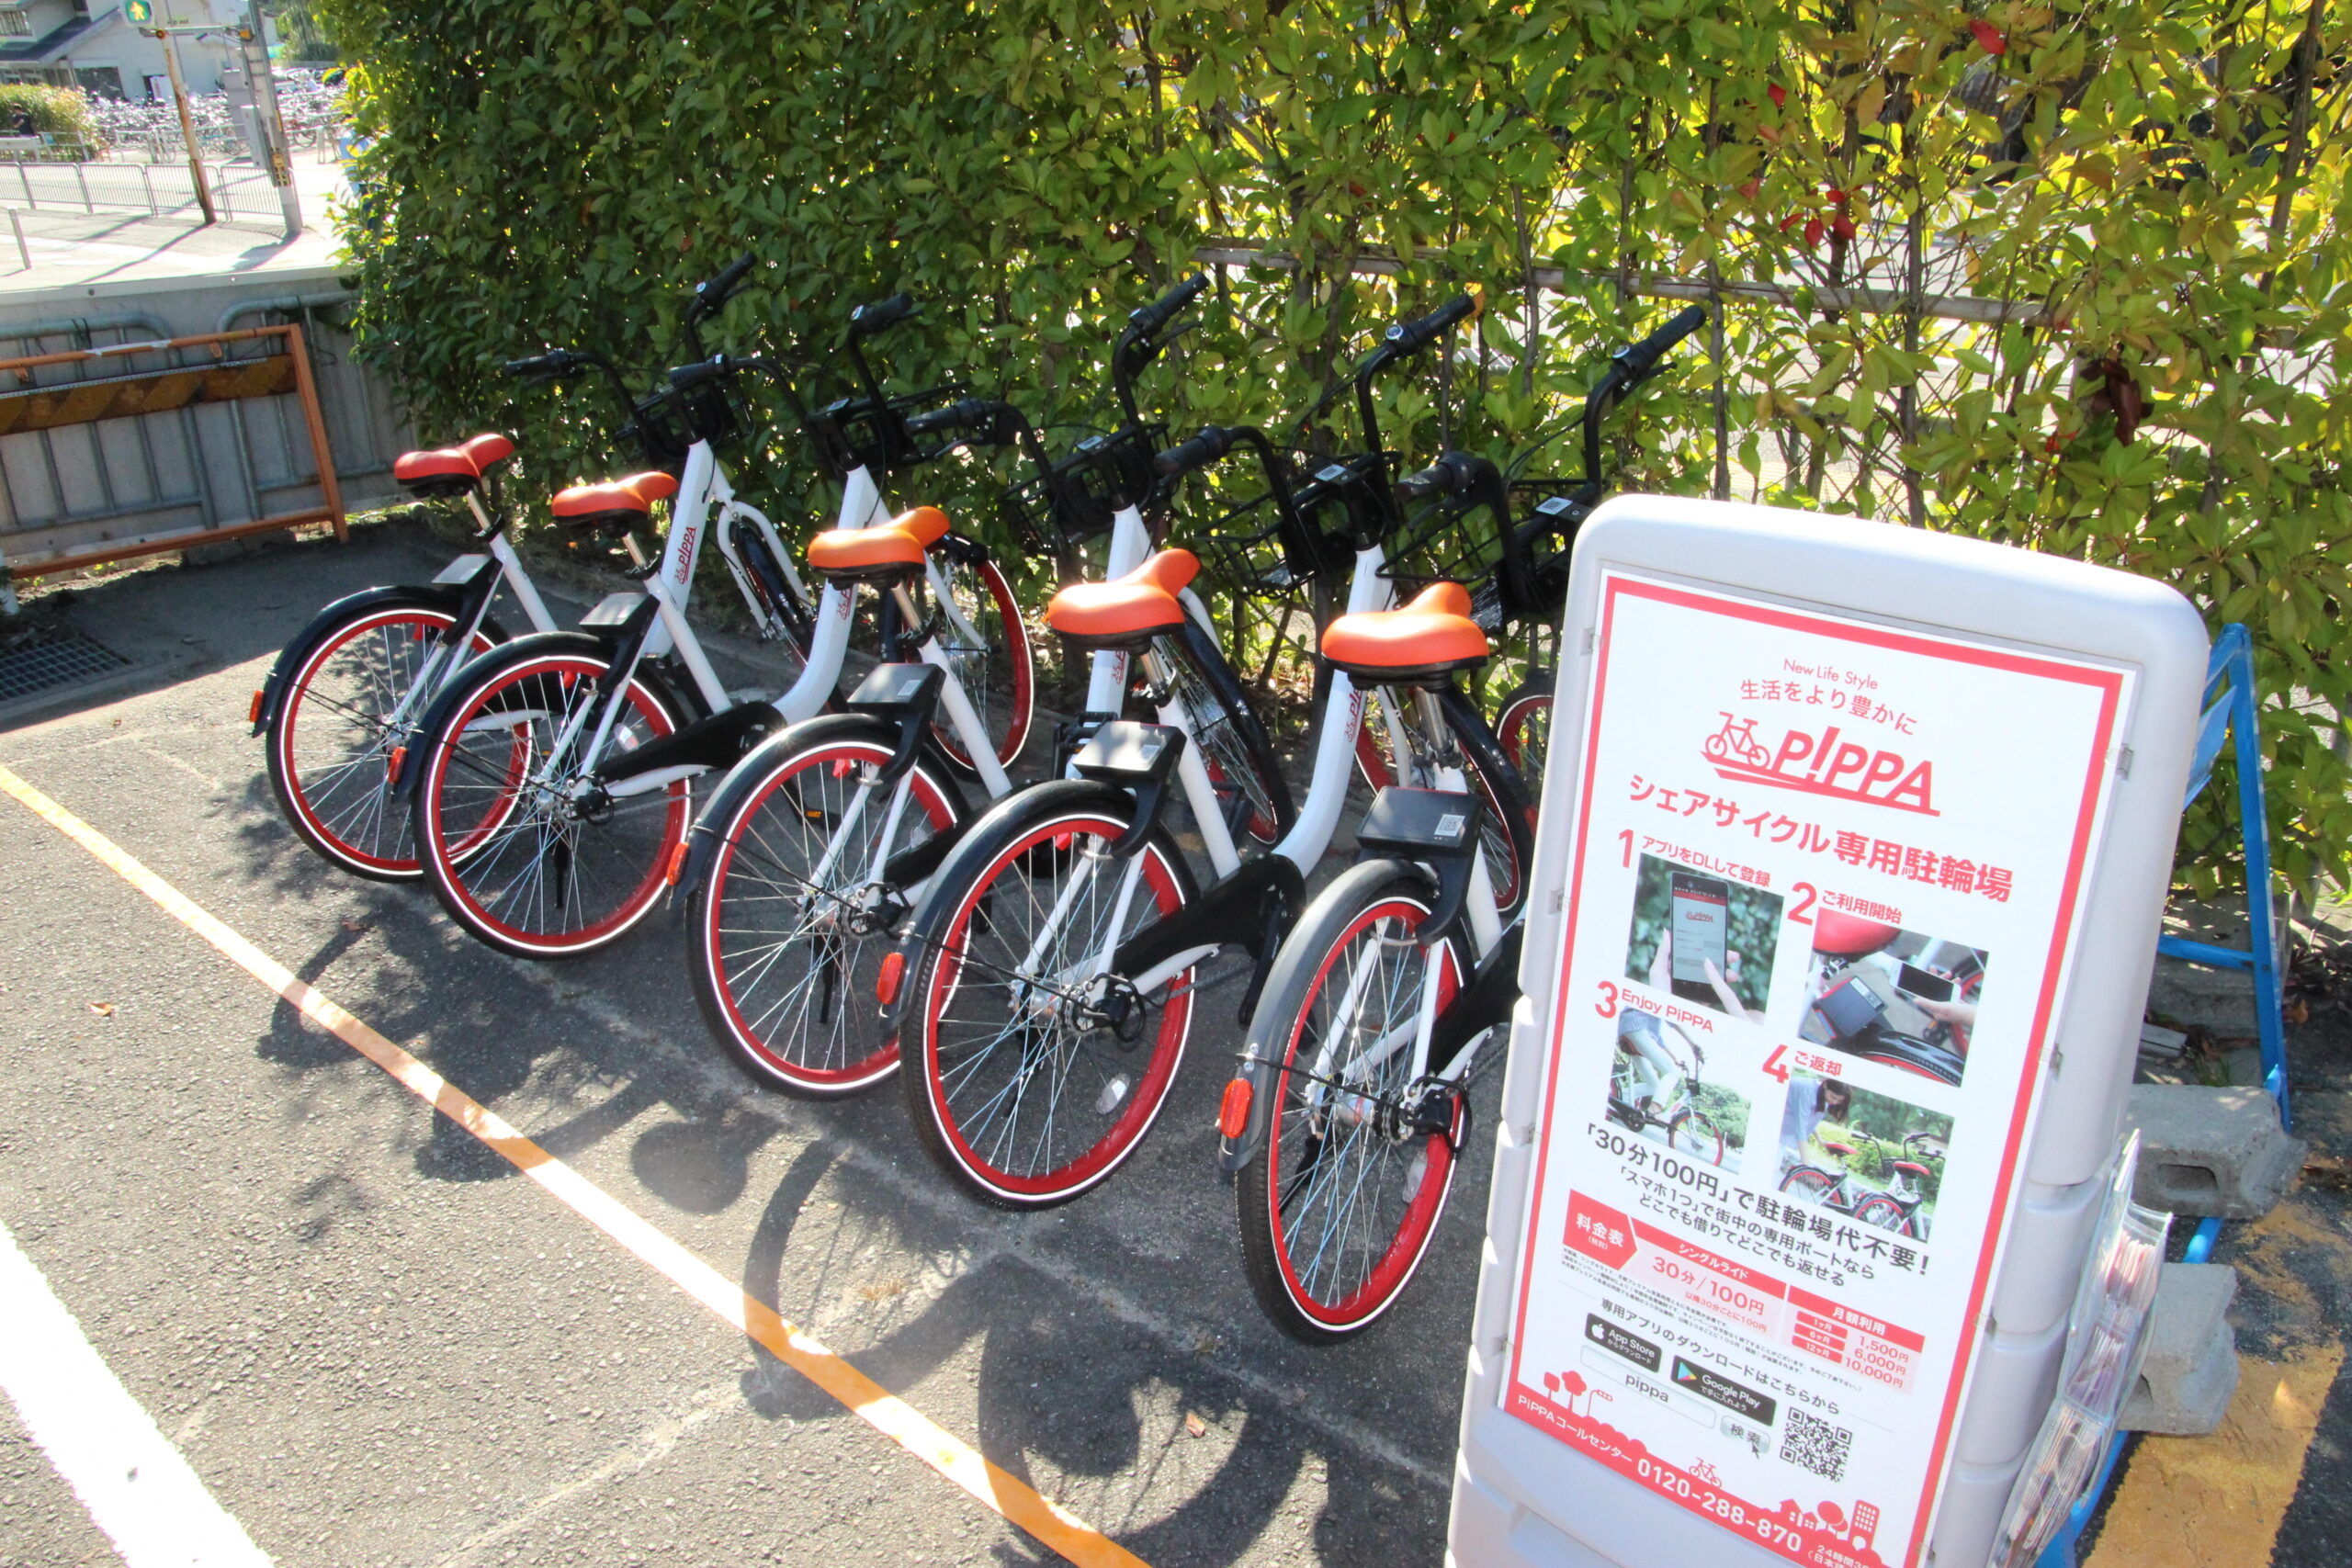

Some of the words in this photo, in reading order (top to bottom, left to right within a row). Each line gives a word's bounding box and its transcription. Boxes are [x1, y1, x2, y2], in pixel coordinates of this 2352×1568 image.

[1782, 658, 1814, 675] New
[1816, 665, 1839, 682] Life
[1845, 671, 1879, 691] Style
[1740, 678, 1917, 736] 生活をより豊かに
[1629, 774, 2014, 904] シェアサイクル専用駐輪場
[1618, 829, 1634, 869] 1
[1642, 836, 1771, 888] アプリをDLして登録
[1787, 882, 1816, 926] 2
[1822, 889, 1903, 925] ご利用開始
[1594, 980, 1618, 1019] 3
[1622, 987, 1662, 1019] Enjoy
[1762, 1044, 1789, 1084] 4
[1794, 1051, 1842, 1077] ご返却
[1576, 1212, 1624, 1247] 料金表
[1639, 1192, 1845, 1287] どこでも借りてどこでも返せる
[1679, 1243, 1749, 1280] シングルライド
[1832, 1306, 1886, 1336] 月額利用
[1600, 1298, 1840, 1416] 専用アプリのダウンロードはこちらから
[1609, 1329, 1629, 1345] App
[1629, 1337, 1656, 1359] Store
[1854, 1348, 1906, 1376] 6,000円
[1859, 1336, 1909, 1363] 1,500円
[1625, 1373, 1669, 1403] pippa
[1845, 1358, 1904, 1388] 10,000円
[1702, 1374, 1738, 1400] Google
[1738, 1391, 1761, 1409] Play
[1730, 1424, 1763, 1446] 検索
[1637, 1458, 1802, 1552] 0120-288-870
